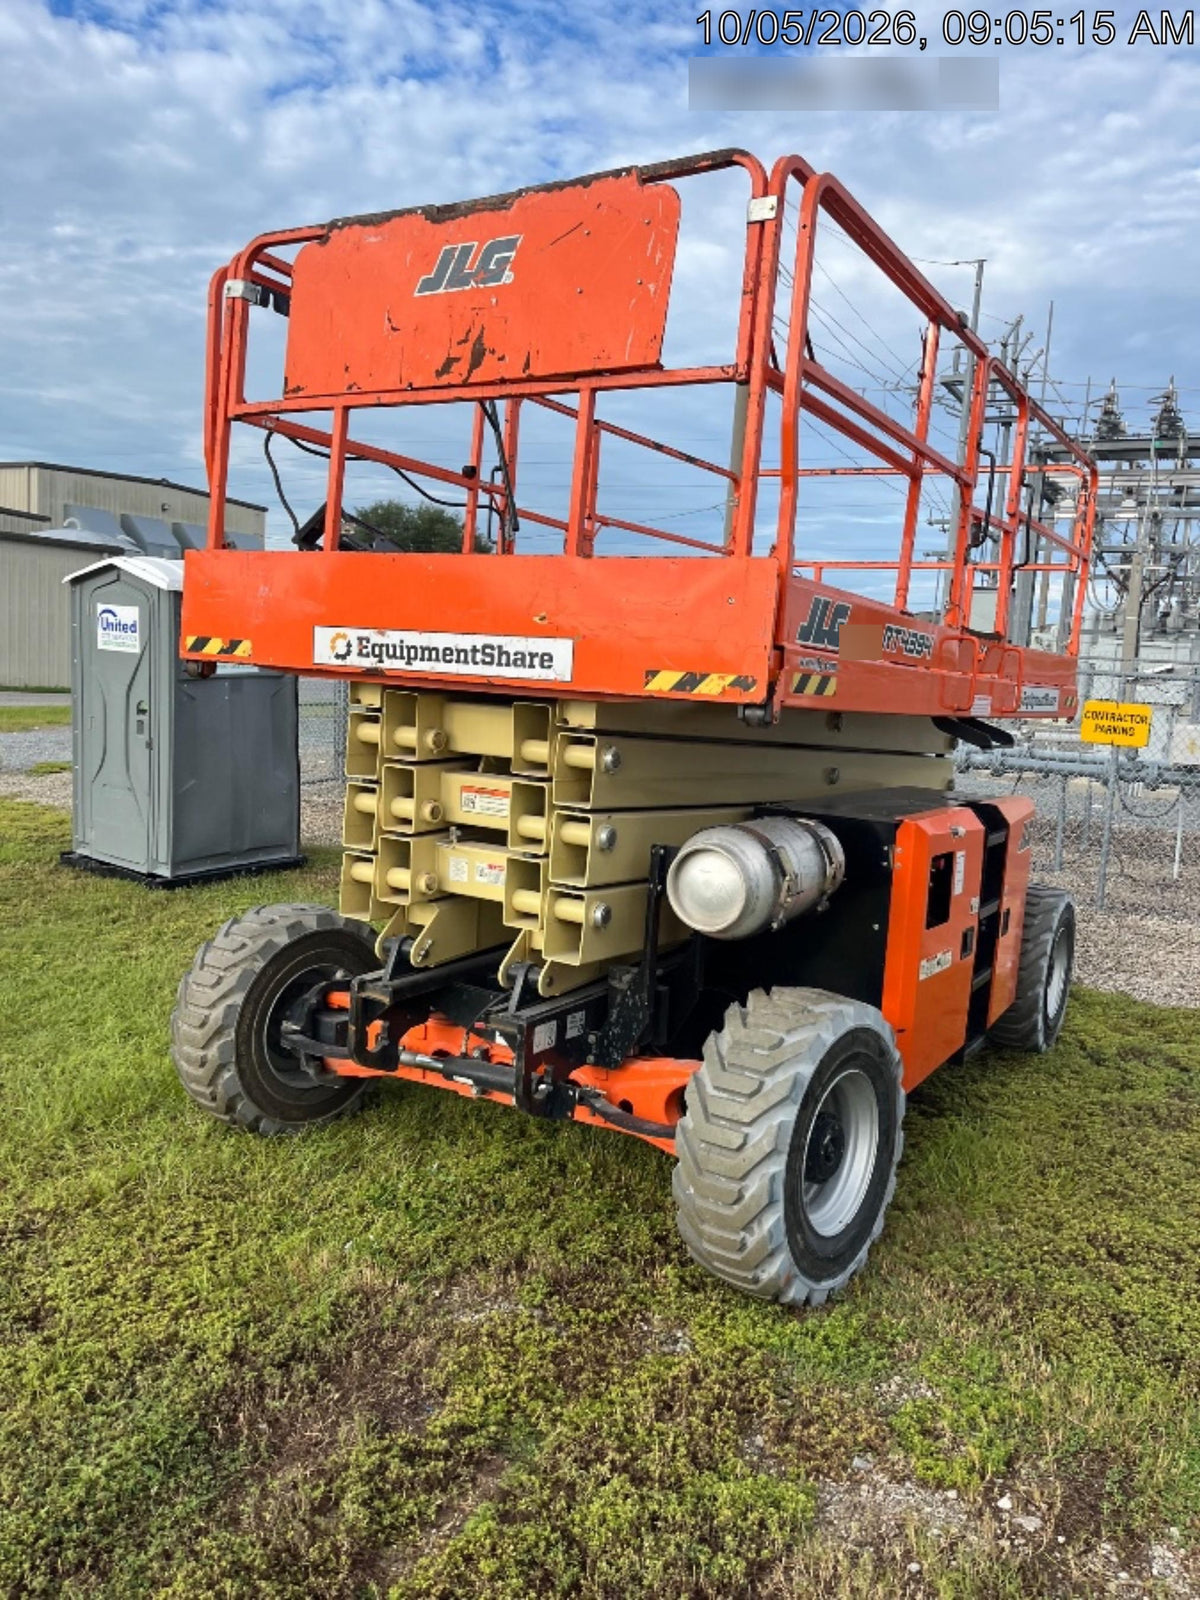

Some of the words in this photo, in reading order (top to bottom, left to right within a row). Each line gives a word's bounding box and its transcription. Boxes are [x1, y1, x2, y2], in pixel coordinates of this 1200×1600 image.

[414, 234, 524, 297] JLG
[100, 616, 138, 634] United
[356, 636, 554, 670] EquipmentShare
[1083, 709, 1149, 725] CONTRACTOR
[1093, 723, 1136, 737] PARKING
